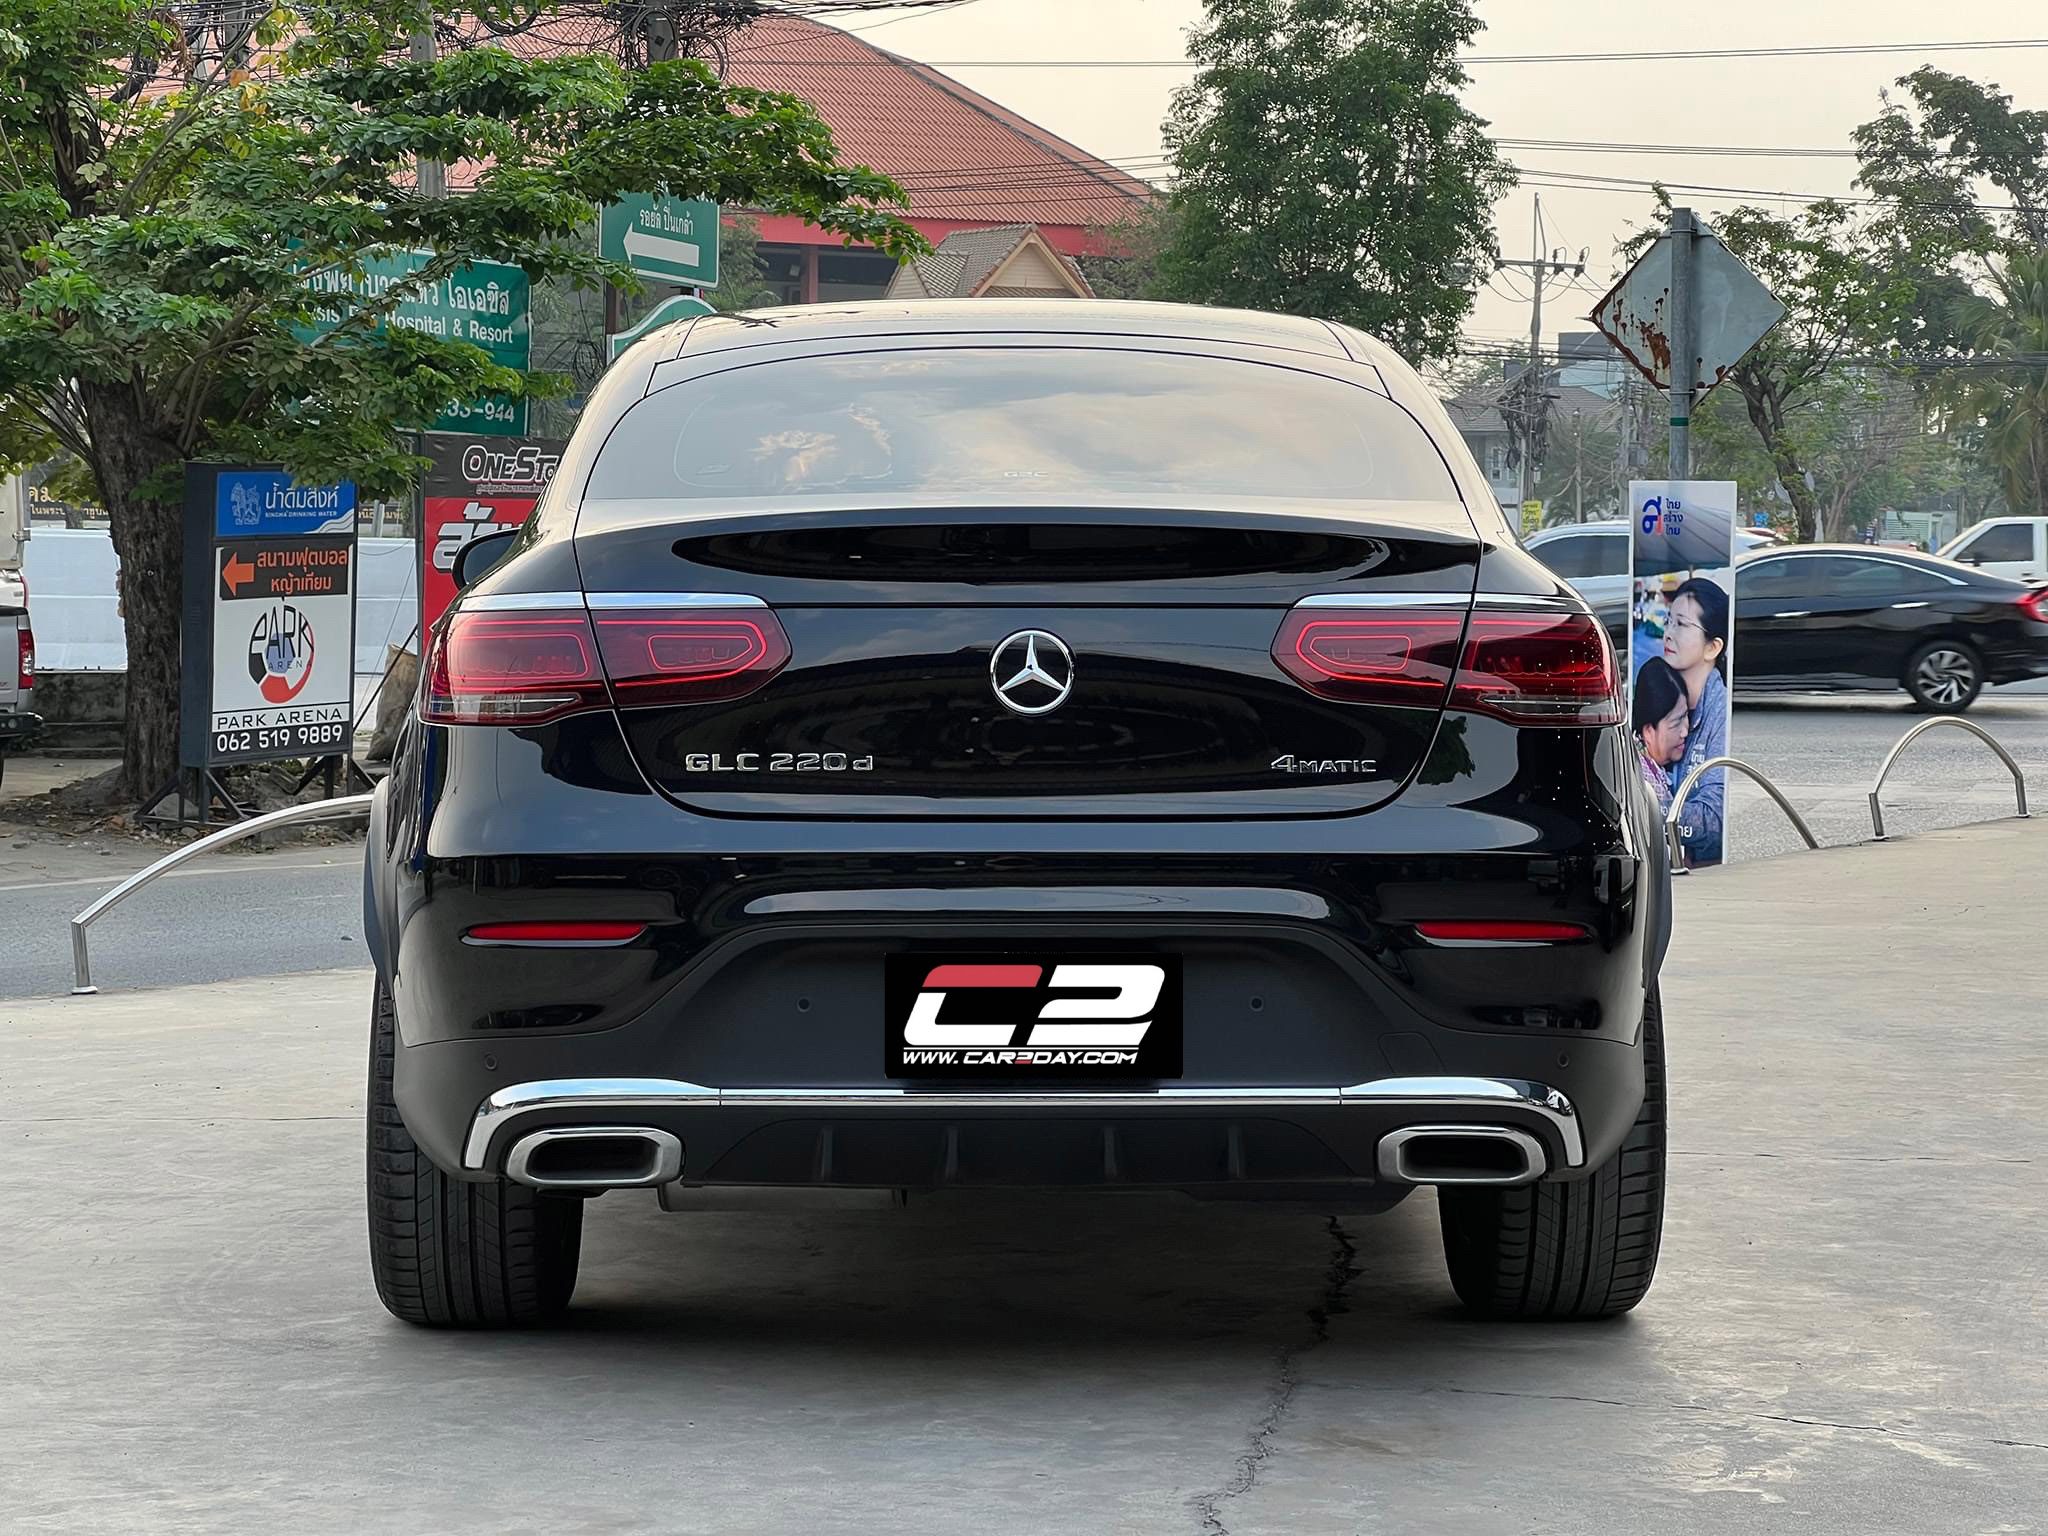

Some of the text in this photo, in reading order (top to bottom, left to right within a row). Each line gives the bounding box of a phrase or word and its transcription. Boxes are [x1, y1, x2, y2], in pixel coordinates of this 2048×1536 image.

[663, 200, 694, 236] ปิ่นเกล้า
[385, 310, 446, 336] Hospital
[453, 318, 464, 337] &
[469, 320, 513, 344] Resort
[265, 482, 340, 509] น้ำดืมสิงห์
[1665, 498, 1681, 510] ไทย
[257, 546, 348, 573] สนามฟุตบอล
[271, 571, 332, 595] หญ้าเทียม
[248, 604, 315, 660] PARK
[217, 708, 342, 730] PARK ARENA
[216, 724, 342, 752] 062 519 9889
[685, 753, 760, 772] GLC
[1270, 754, 1377, 773] 4MATIC
